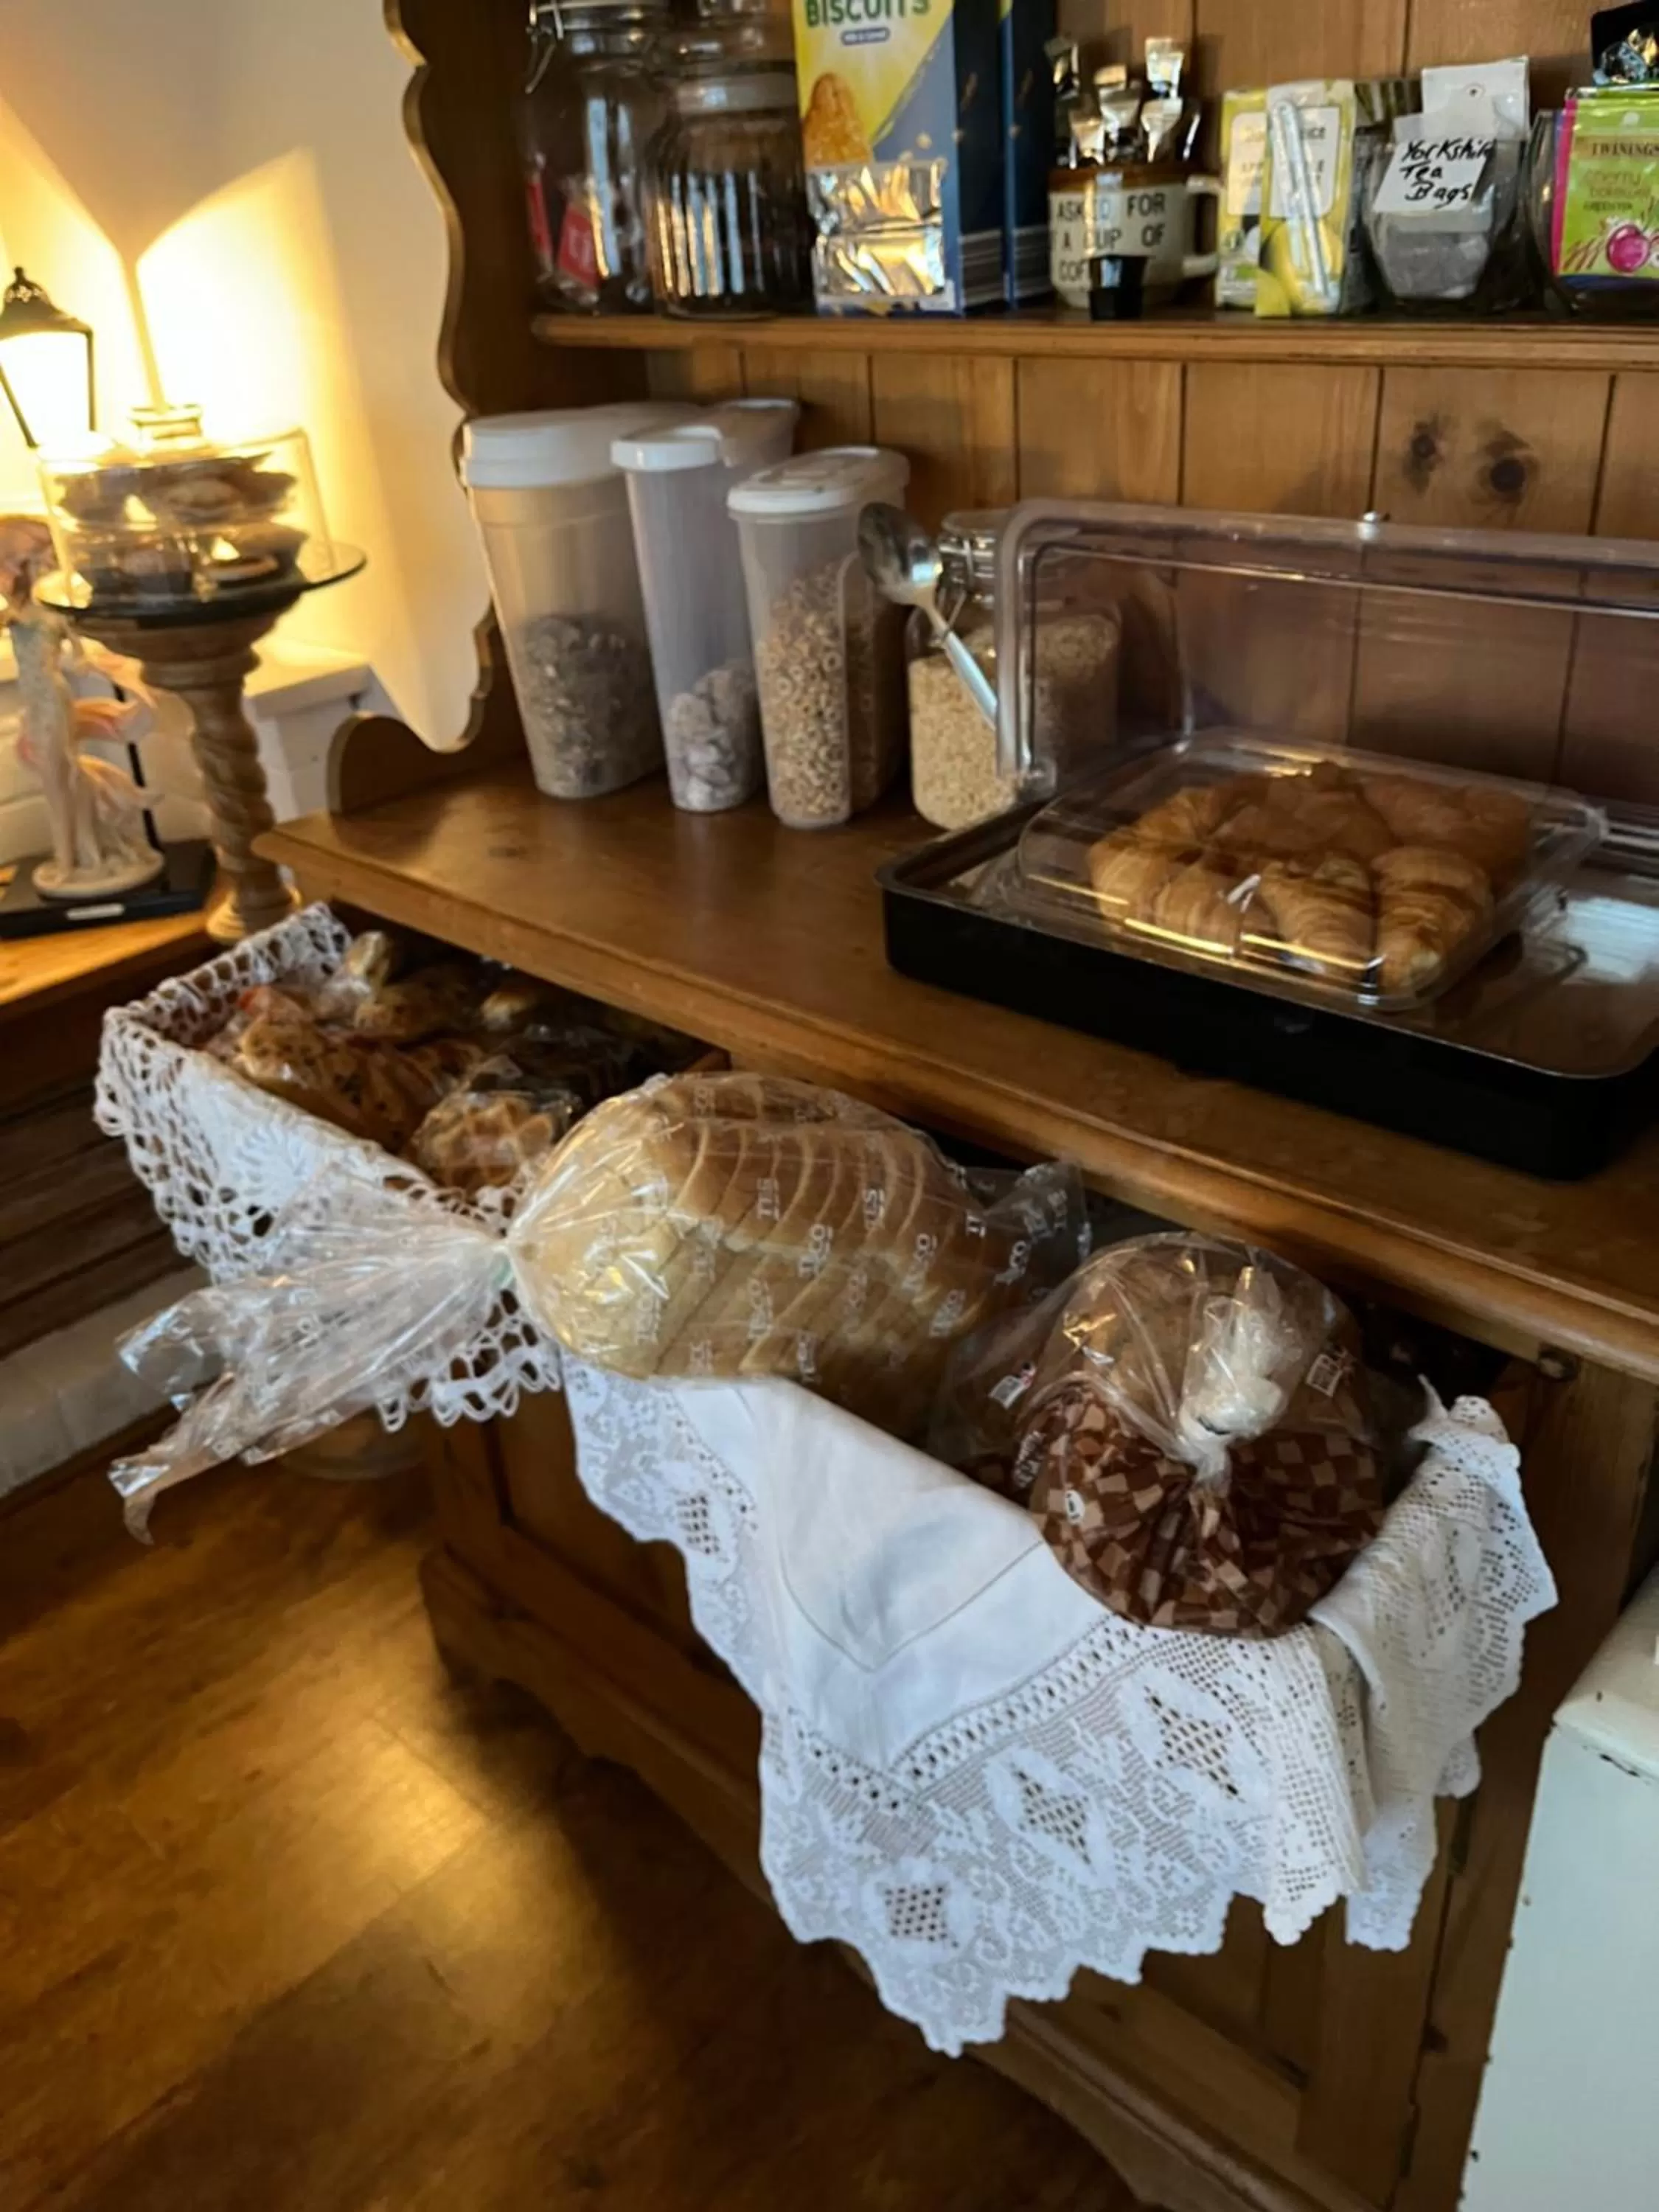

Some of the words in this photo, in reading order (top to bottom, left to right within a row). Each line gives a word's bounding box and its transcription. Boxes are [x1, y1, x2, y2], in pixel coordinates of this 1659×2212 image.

[806, 0, 930, 28] BISCUITS
[1399, 159, 1443, 181] Tea
[1057, 198, 1111, 221] ASKD
[1127, 192, 1165, 218] FOR
[1404, 181, 1472, 209] Bags
[1062, 231, 1072, 251] A
[1141, 223, 1165, 248] OF
